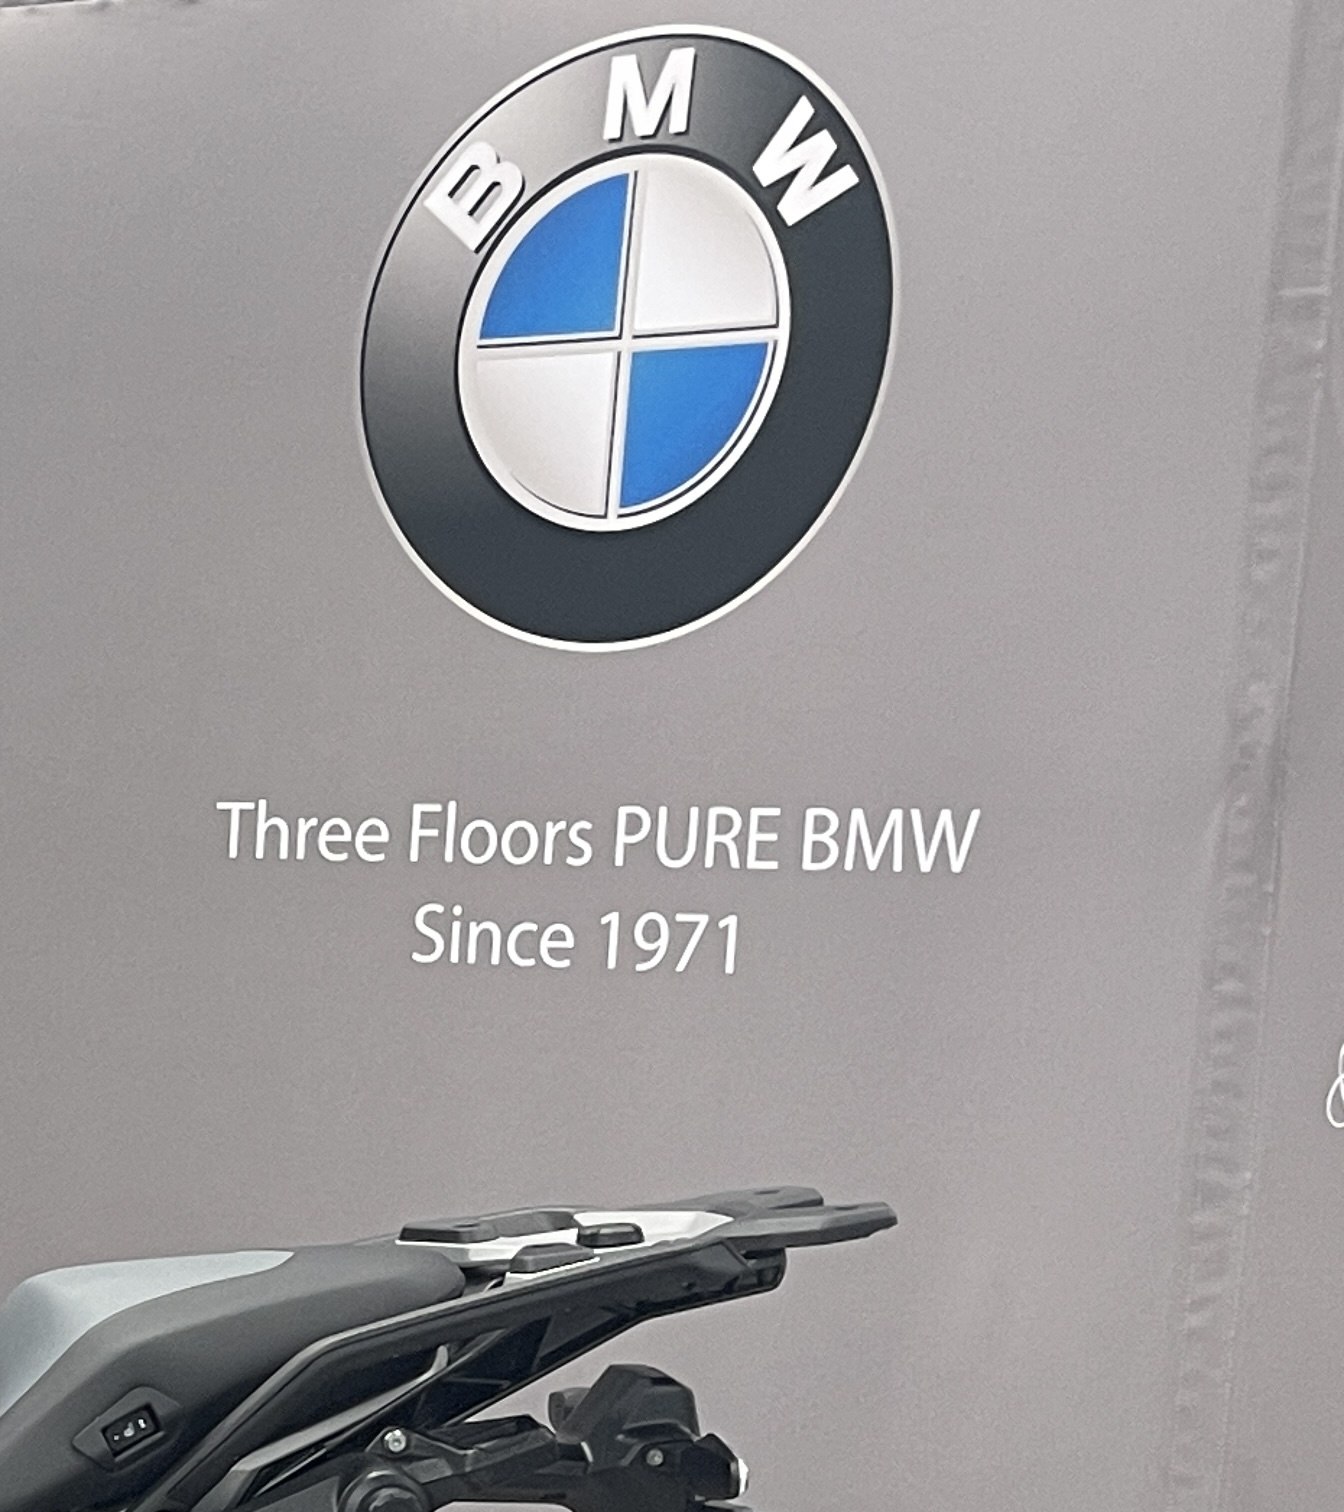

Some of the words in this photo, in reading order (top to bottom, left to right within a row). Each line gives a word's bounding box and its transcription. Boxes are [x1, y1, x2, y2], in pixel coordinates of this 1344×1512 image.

[423, 47, 860, 253] BMW
[215, 797, 391, 863] Three
[408, 799, 594, 868] Floors
[613, 804, 782, 871] PURE
[800, 806, 982, 875] BMW
[410, 902, 576, 969] Since
[599, 910, 740, 976] 1971
